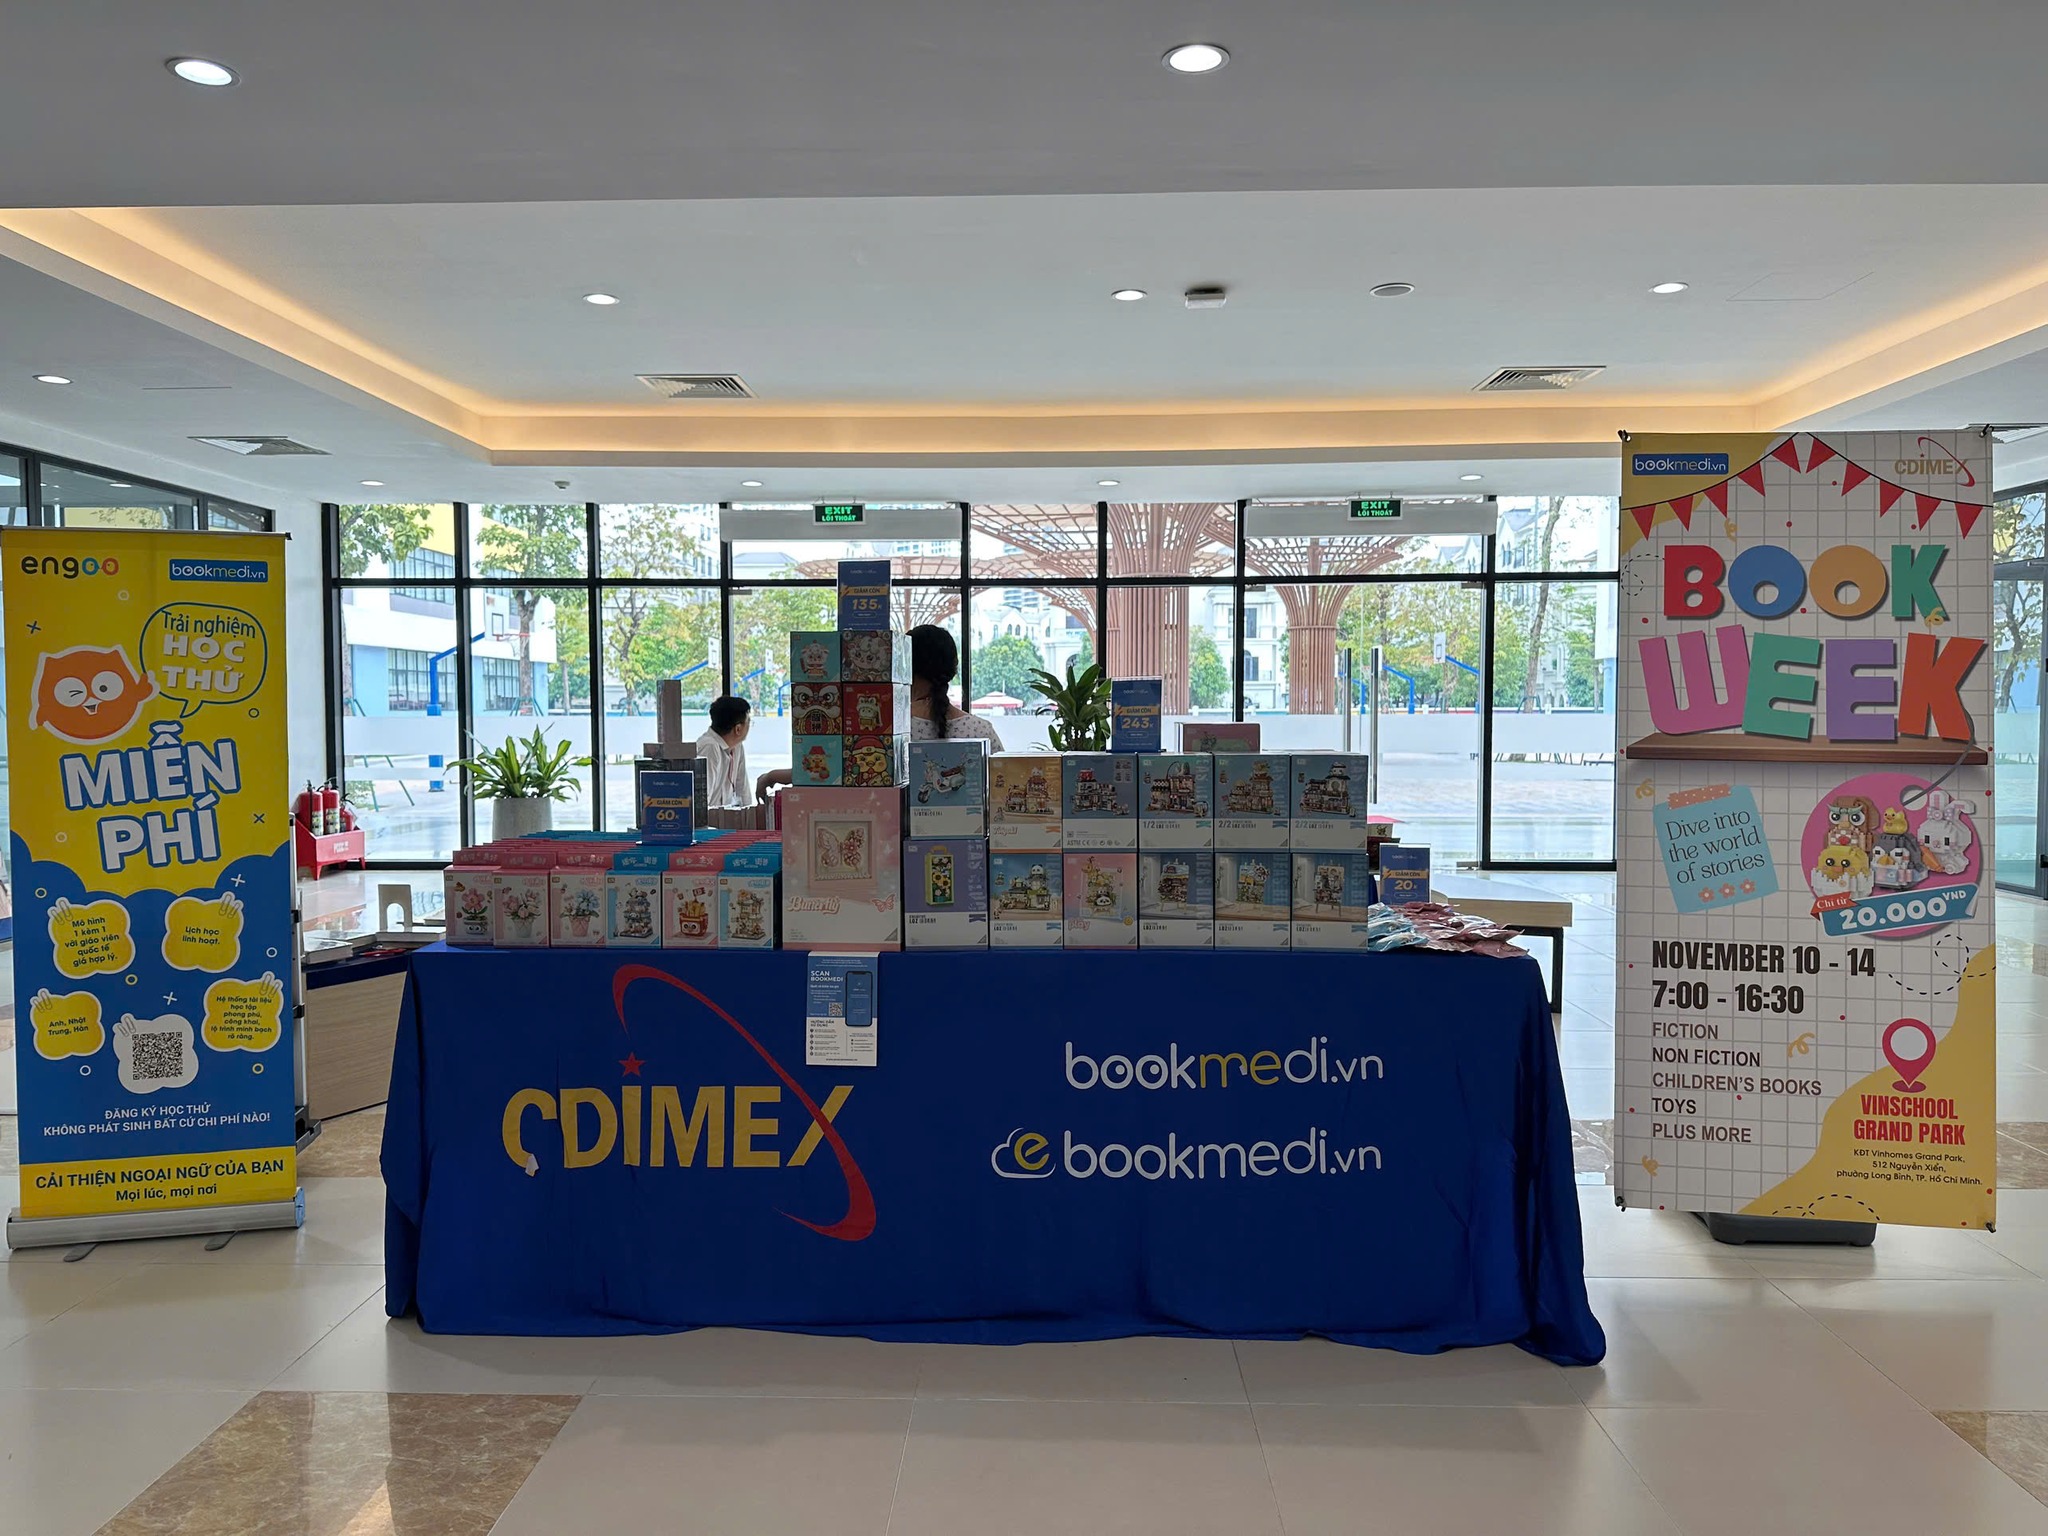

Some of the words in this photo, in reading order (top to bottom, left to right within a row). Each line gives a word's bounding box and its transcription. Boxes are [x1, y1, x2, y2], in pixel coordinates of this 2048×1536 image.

[1635, 457, 1726, 472] bookmedi.vn
[1894, 458, 1969, 475] CDIMEX
[825, 506, 853, 514] EXIT
[1361, 501, 1390, 509] EXIT
[21, 555, 119, 579] engoo
[172, 563, 266, 579] bookmedi.vn
[1663, 544, 1948, 620] BOOK
[162, 609, 190, 633] Trải
[193, 615, 256, 639] nghiệm
[163, 634, 245, 663] HỌC
[162, 664, 245, 693] THỬ
[1638, 624, 1986, 741] WEEK
[62, 722, 239, 808] MIỄN
[99, 792, 219, 870] PHÍ
[1218, 820, 1231, 828] 2/2
[1665, 819, 1711, 841] Dive
[1713, 811, 1751, 830] into
[1668, 843, 1699, 863] the
[1703, 826, 1761, 855] world
[1677, 861, 1696, 884] of
[1701, 853, 1765, 879] stories
[1839, 897, 1947, 930] 20.000
[1942, 890, 1967, 901] VND
[1068, 918, 1091, 932] play
[1652, 940, 1784, 973] NOVEMBER
[1792, 946, 1820, 974] 10
[1847, 948, 1875, 977] 14
[1652, 980, 1709, 1009] 7:00
[1734, 983, 1804, 1014] 16:30
[48, 1027, 72, 1036] Trung,
[49, 1019, 66, 1028] Anh,
[1652, 1022, 1719, 1039] FICTION
[1065, 1036, 1384, 1090] bookmedi.vn
[1652, 1047, 1688, 1063] NON
[1694, 1050, 1760, 1067] FICTION
[1652, 1072, 1754, 1092] CHILDREN'S
[1760, 1078, 1822, 1095] BOOKS
[105, 1108, 138, 1120] ĐĂNG
[141, 1105, 157, 1117] KÝ
[160, 1105, 184, 1117] HỌC
[187, 1102, 211, 1115] THỬ
[1652, 1098, 1697, 1114] TOYS
[1860, 1094, 1958, 1119] VINSCHOOL
[43, 1124, 86, 1136] KHÔNG
[89, 1121, 119, 1134] PHÁT
[123, 1121, 151, 1132] SINH
[154, 1118, 177, 1130] BẤT
[180, 1116, 197, 1128] CỨ
[198, 1116, 217, 1127] CHI
[220, 1113, 240, 1125] PHÍ
[243, 1112, 270, 1123] NÀO!
[502, 1085, 854, 1173] CDIMEX
[1652, 1123, 1696, 1139] PLUS
[1702, 1125, 1751, 1143] MORE
[1853, 1119, 1912, 1142] GRAND
[1919, 1123, 1966, 1145] PARK
[1063, 1126, 1382, 1180] bookmedi.vn
[1853, 1149, 1870, 1157] KĐT
[1871, 1150, 1913, 1159] Vinhomes
[1915, 1153, 1942, 1161] Grand
[1944, 1154, 1966, 1163] Park,
[1872, 1161, 1888, 1169] 512
[36, 1171, 63, 1188] CẢI
[67, 1170, 115, 1187] THIỆN
[121, 1167, 171, 1184] NGOẠI
[176, 1162, 212, 1178] NGỮ
[214, 1160, 247, 1176] CỦA
[251, 1159, 284, 1175] BẠN
[1871, 1172, 1892, 1181] Long
[1916, 1174, 1927, 1182] TP.
[1959, 1177, 1983, 1185] Minh.
[116, 1187, 140, 1202] Mọi
[144, 1185, 166, 1200] lúc,
[170, 1185, 194, 1199] mọi
[197, 1184, 217, 1195] nơi
